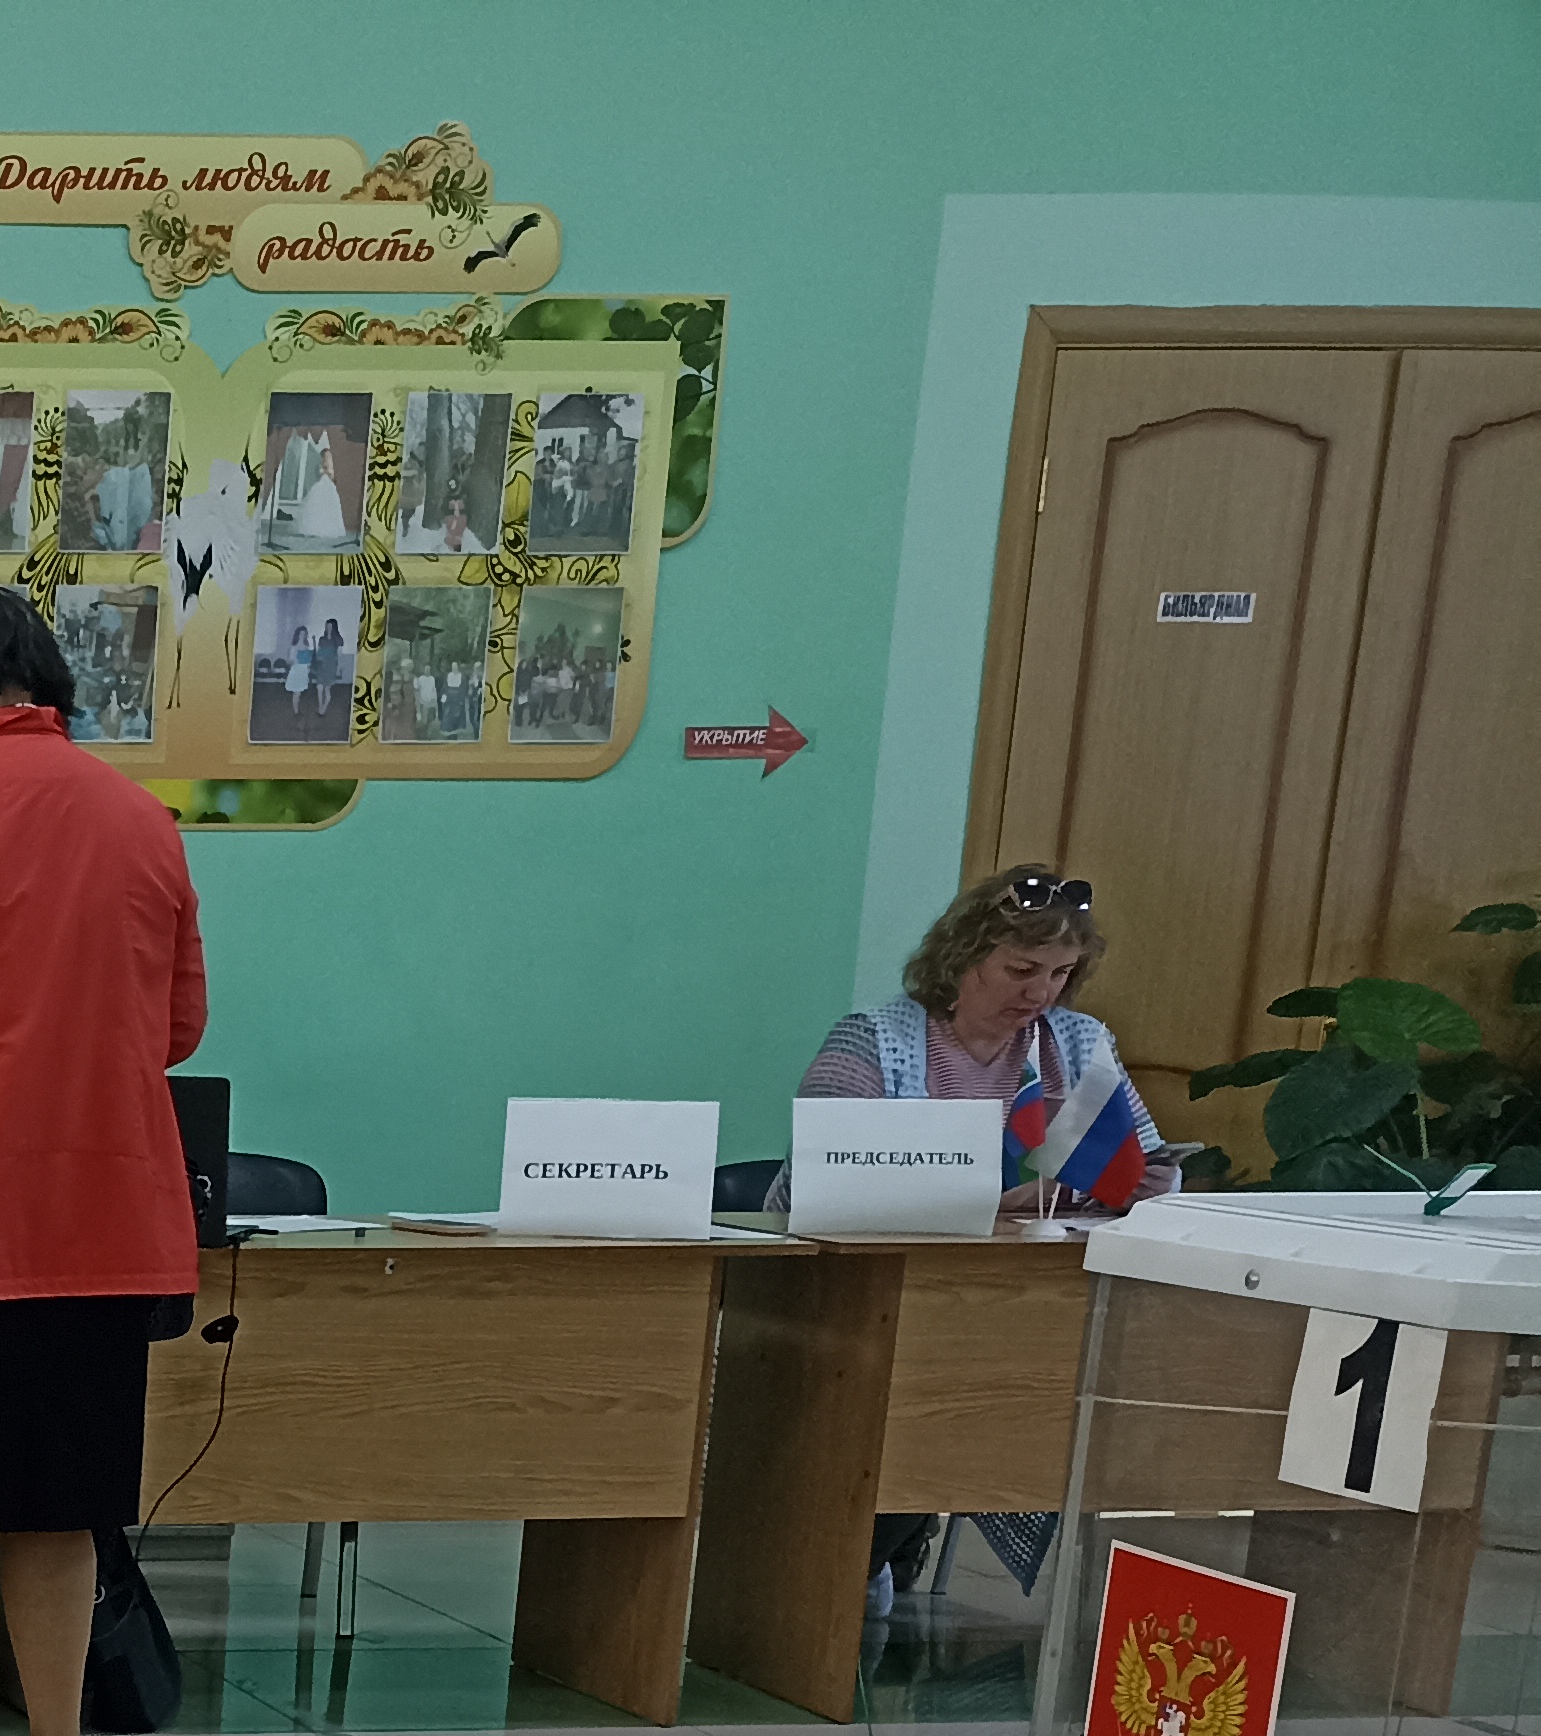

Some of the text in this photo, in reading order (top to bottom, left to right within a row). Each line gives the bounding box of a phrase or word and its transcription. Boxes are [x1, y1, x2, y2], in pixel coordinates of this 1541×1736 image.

[181, 152, 332, 193] людям
[256, 221, 435, 275] радость
[1161, 594, 1252, 620] БИЛЬЯРДНАЯ
[693, 729, 767, 746] УКРЫТИЕ
[523, 1161, 670, 1181] СЕКРЕТАРЬ
[825, 1150, 975, 1168] ПРЕДСЕДАТЕЛЬ
[1334, 1318, 1401, 1494] 1
